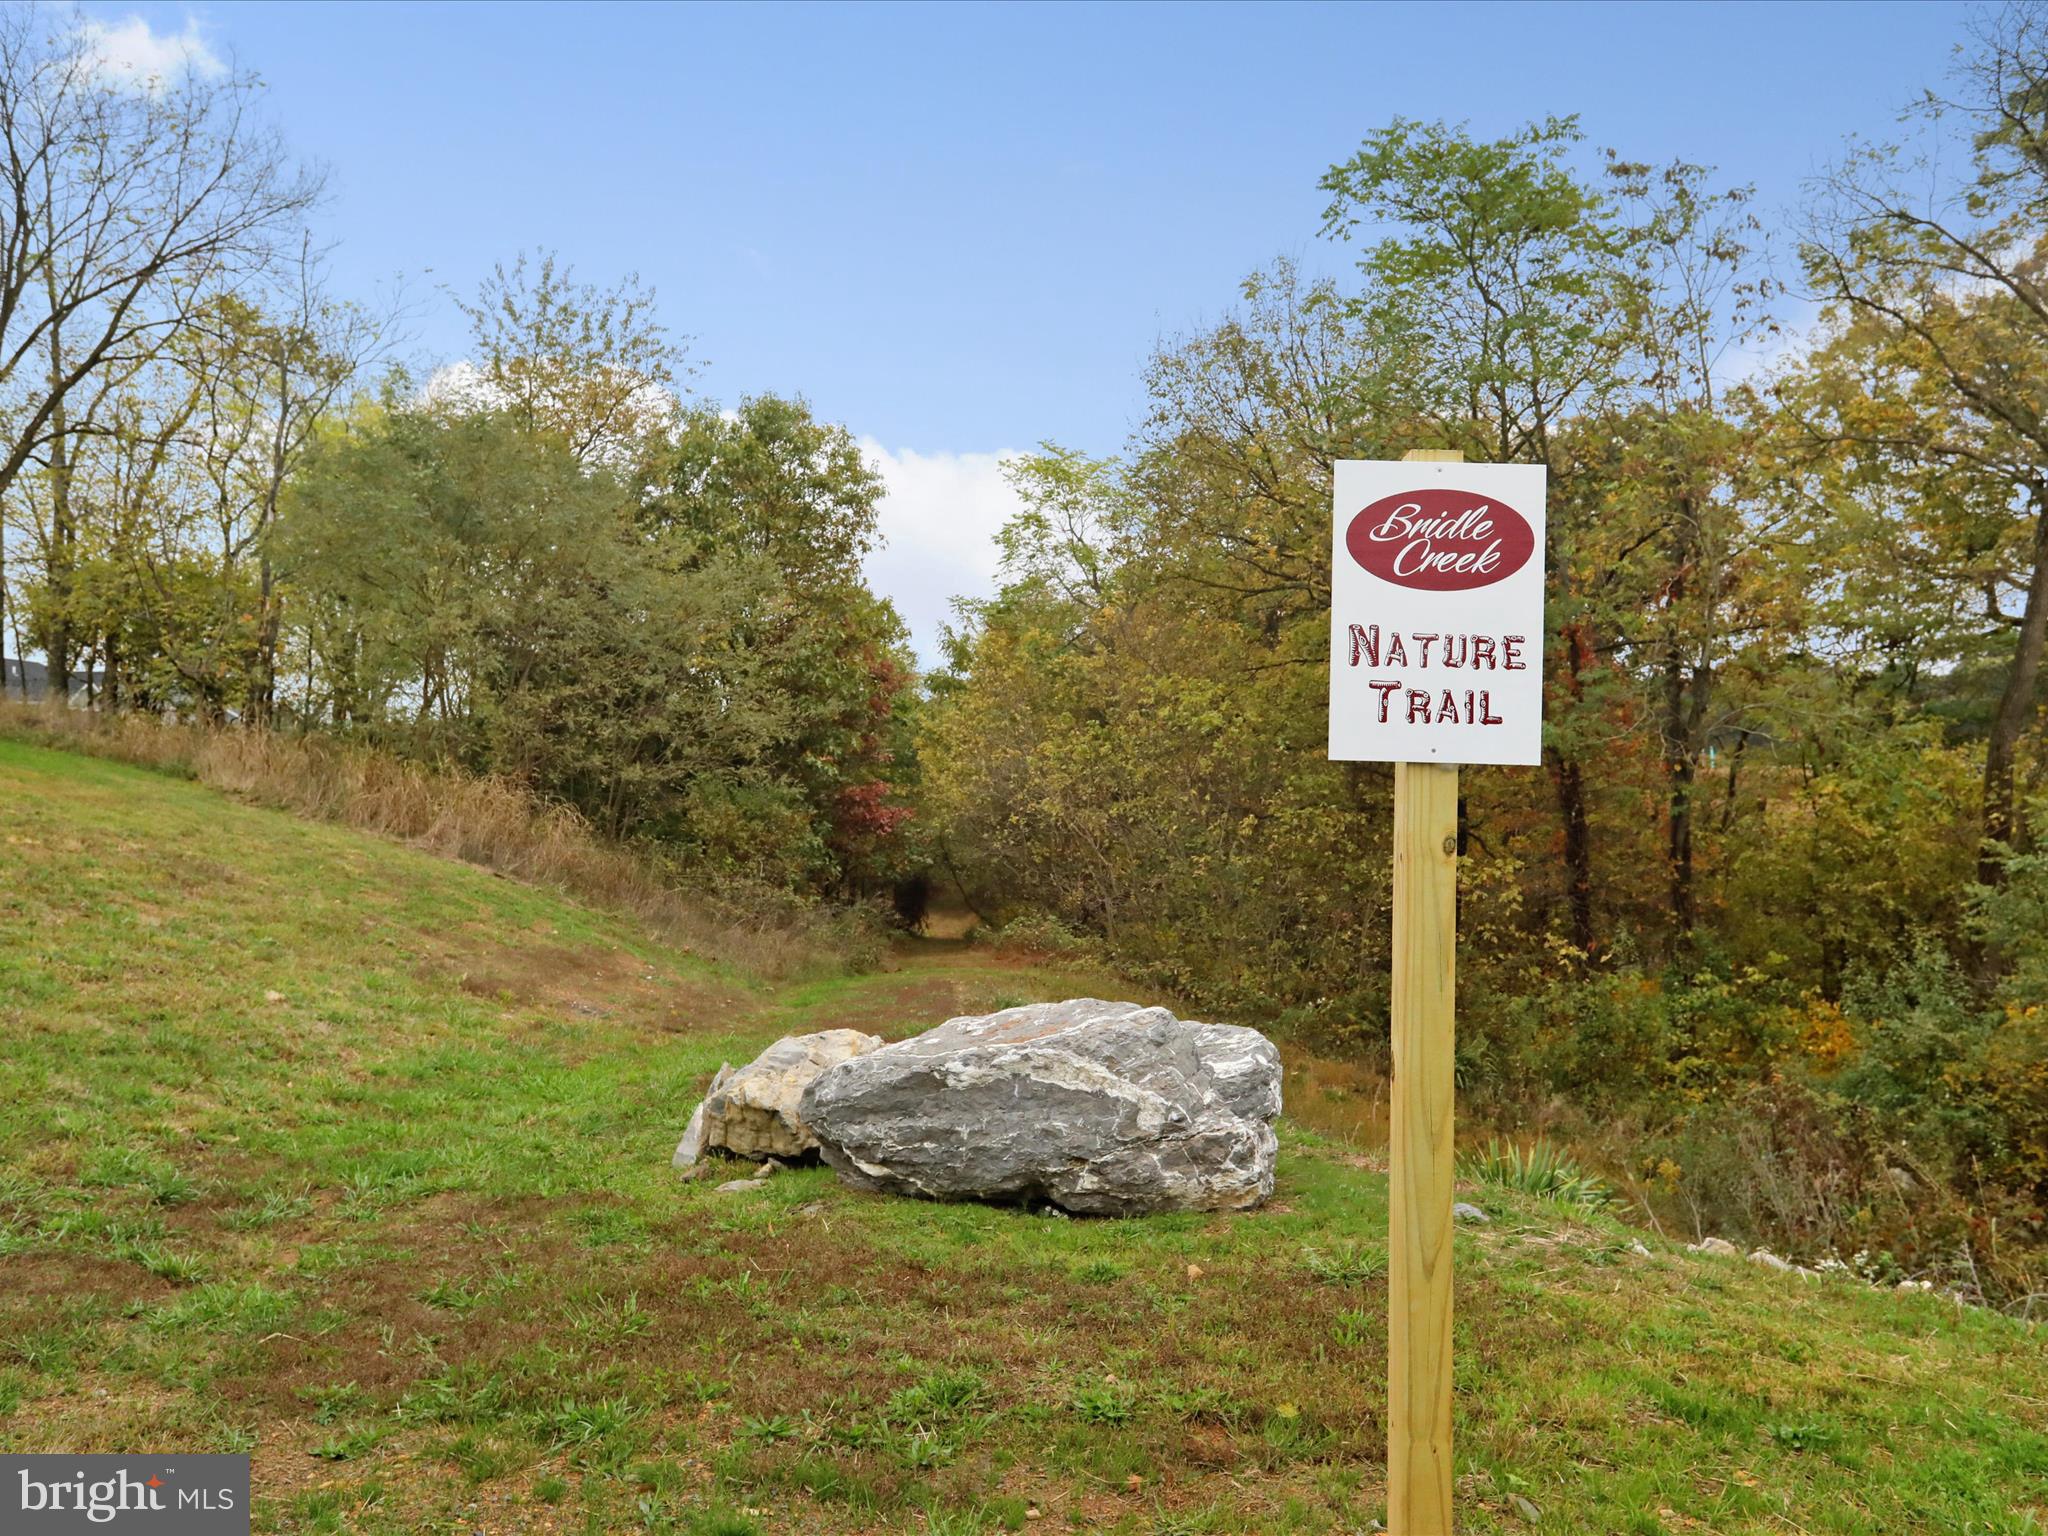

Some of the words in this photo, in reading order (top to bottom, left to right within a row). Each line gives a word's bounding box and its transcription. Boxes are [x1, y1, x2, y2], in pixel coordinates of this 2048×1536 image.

[1369, 503, 1495, 542] Bridle
[1393, 538, 1502, 577] Creek
[1348, 624, 1527, 670] NATURE
[1368, 680, 1503, 725] TRAIL
